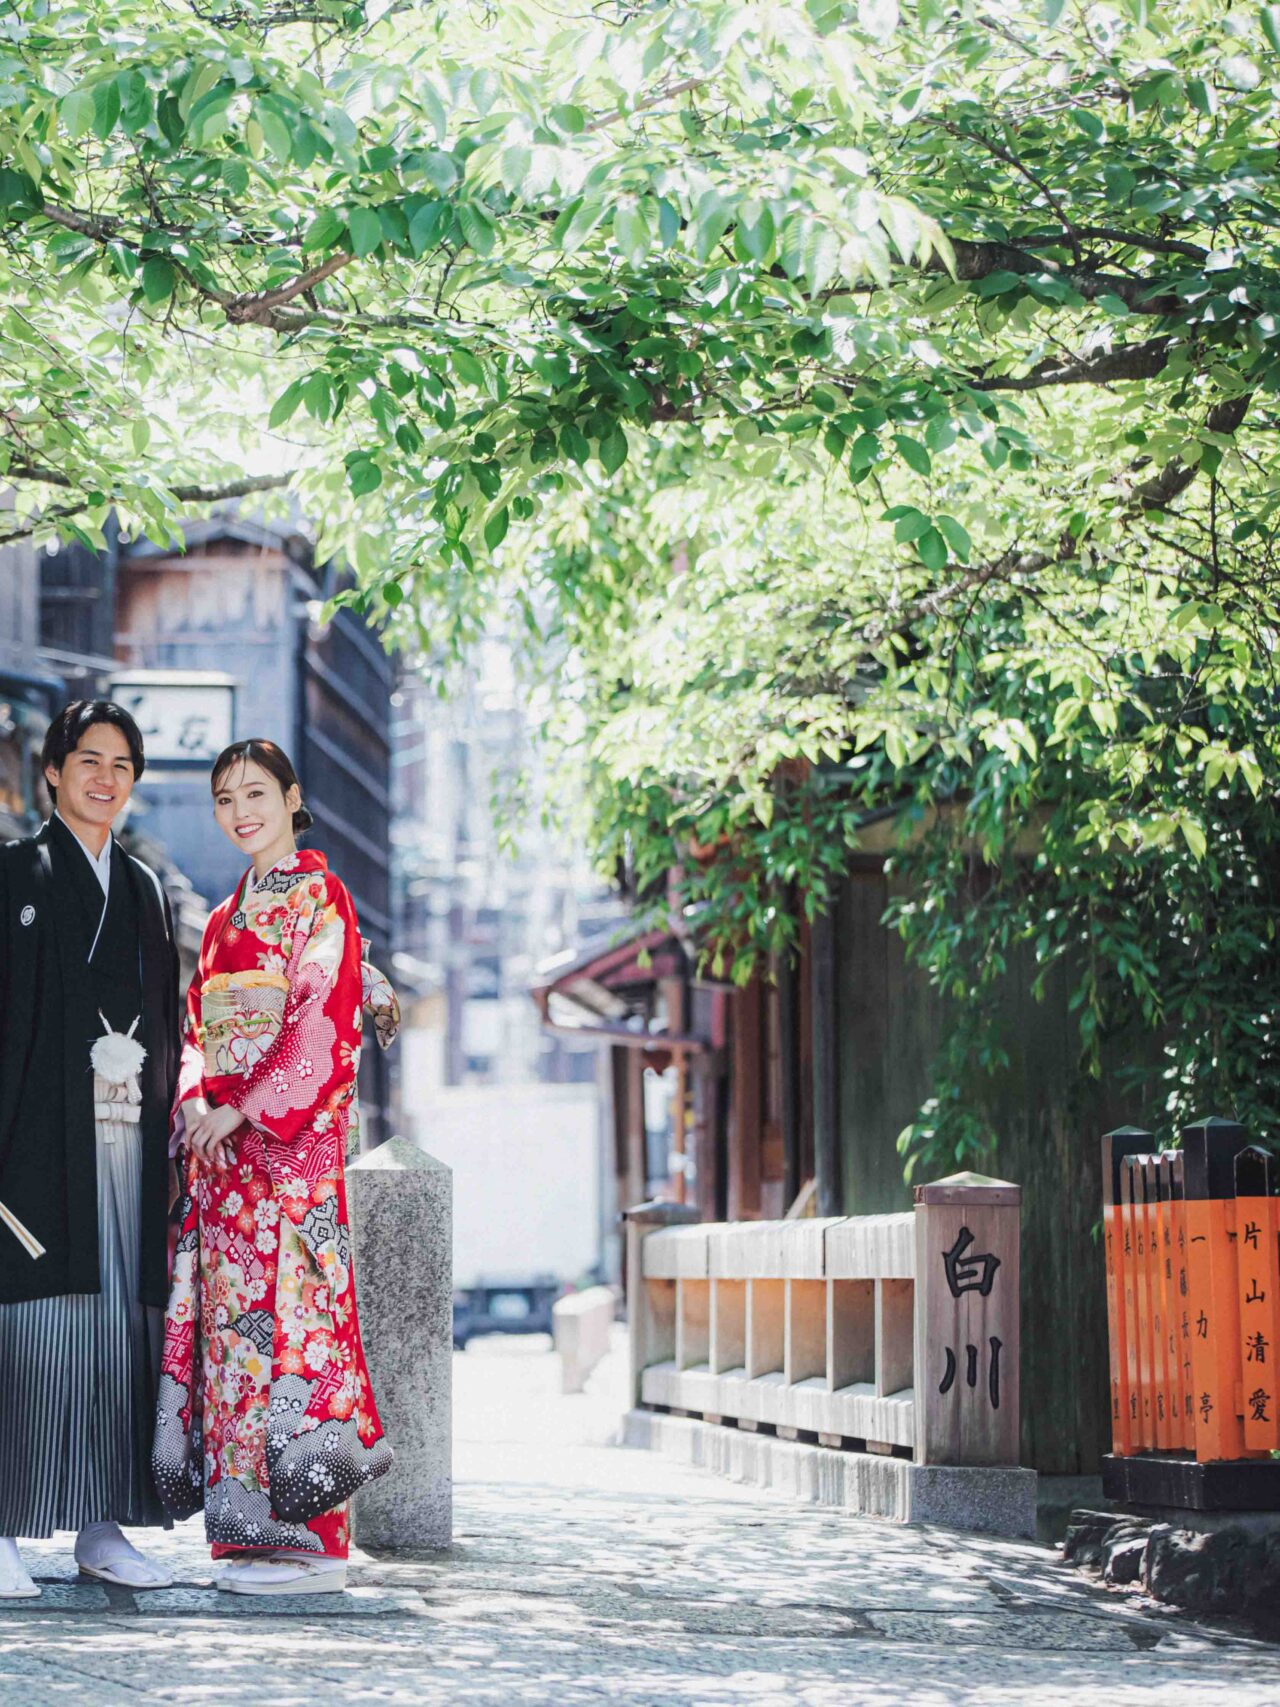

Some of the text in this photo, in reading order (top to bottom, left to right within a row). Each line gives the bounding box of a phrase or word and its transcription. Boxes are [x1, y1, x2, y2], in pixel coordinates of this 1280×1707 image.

[938, 1225, 1002, 1410] 白川
[1190, 1234, 1214, 1425] 一力亭
[1243, 1221, 1271, 1423] 片山清愛
